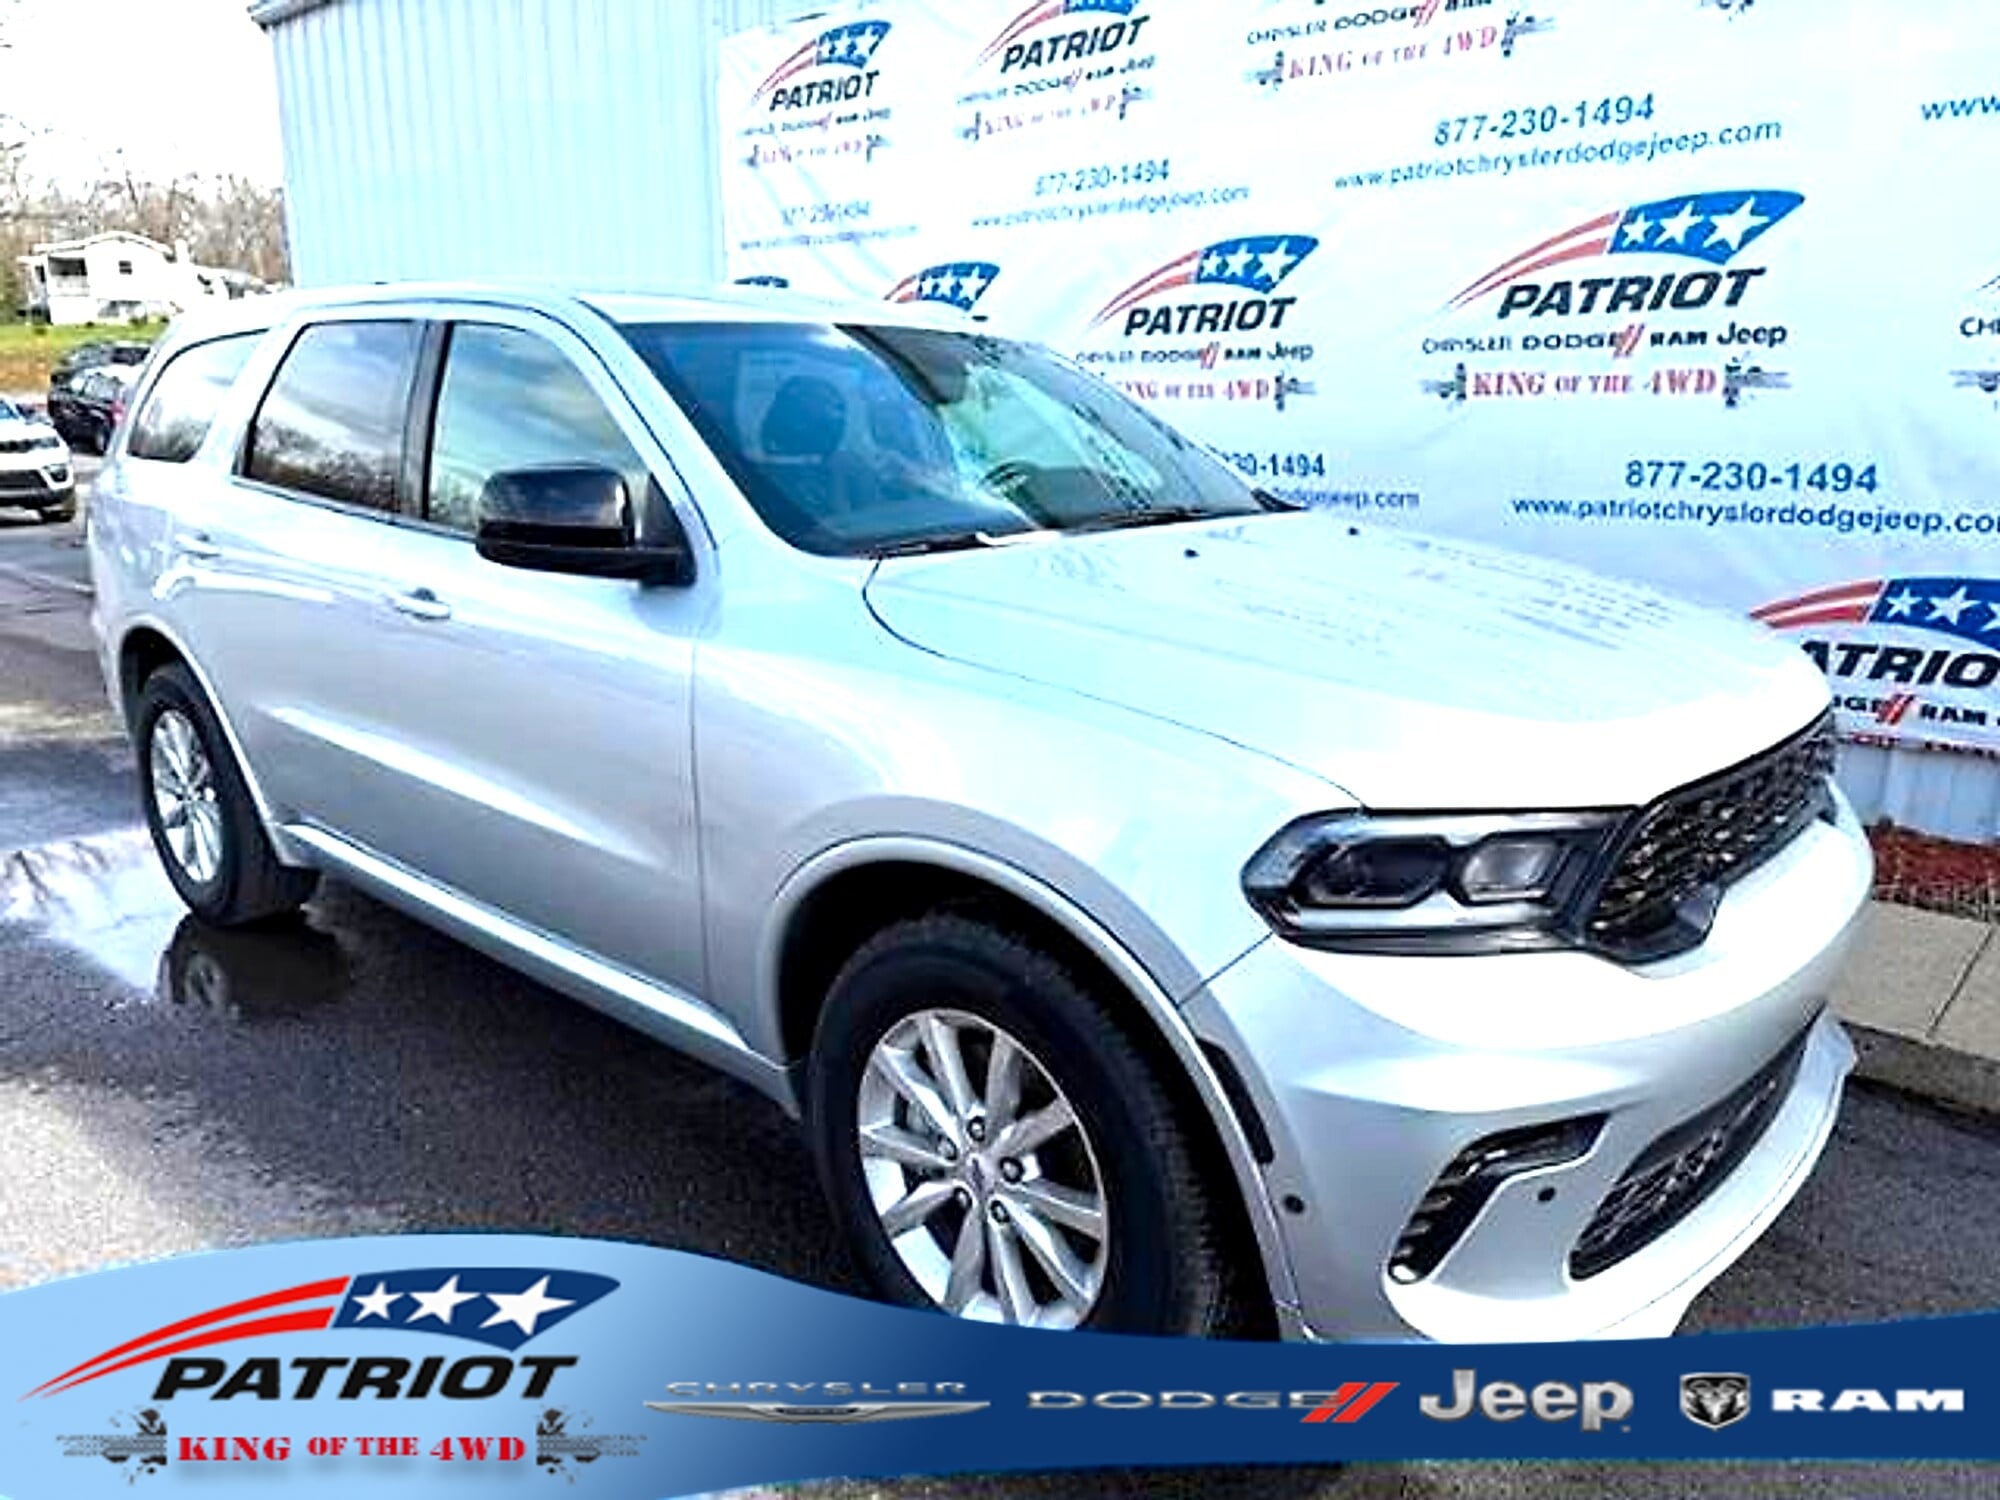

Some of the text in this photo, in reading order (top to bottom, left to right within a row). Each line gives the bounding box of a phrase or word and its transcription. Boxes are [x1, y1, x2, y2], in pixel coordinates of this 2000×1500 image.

[1000, 15, 1150, 73] PATRIOT
[769, 70, 880, 112] PATRIOT
[1434, 93, 1655, 148] 877-230-1494
[1497, 267, 1766, 319] PATRIOT
[1125, 296, 1297, 336] PATRIOT
[1522, 332, 1620, 351] DODGE
[1650, 330, 1708, 349] RAM
[1717, 321, 1788, 349] Jeep
[1222, 379, 1270, 401] 4WD
[1472, 367, 1717, 397] KING OF THE 4WD
[1625, 459, 1878, 494] 877-230-1494
[1512, 499, 2000, 536] www.patriotchryslerdodgejeep.co
[1920, 703, 1986, 725] RAM
